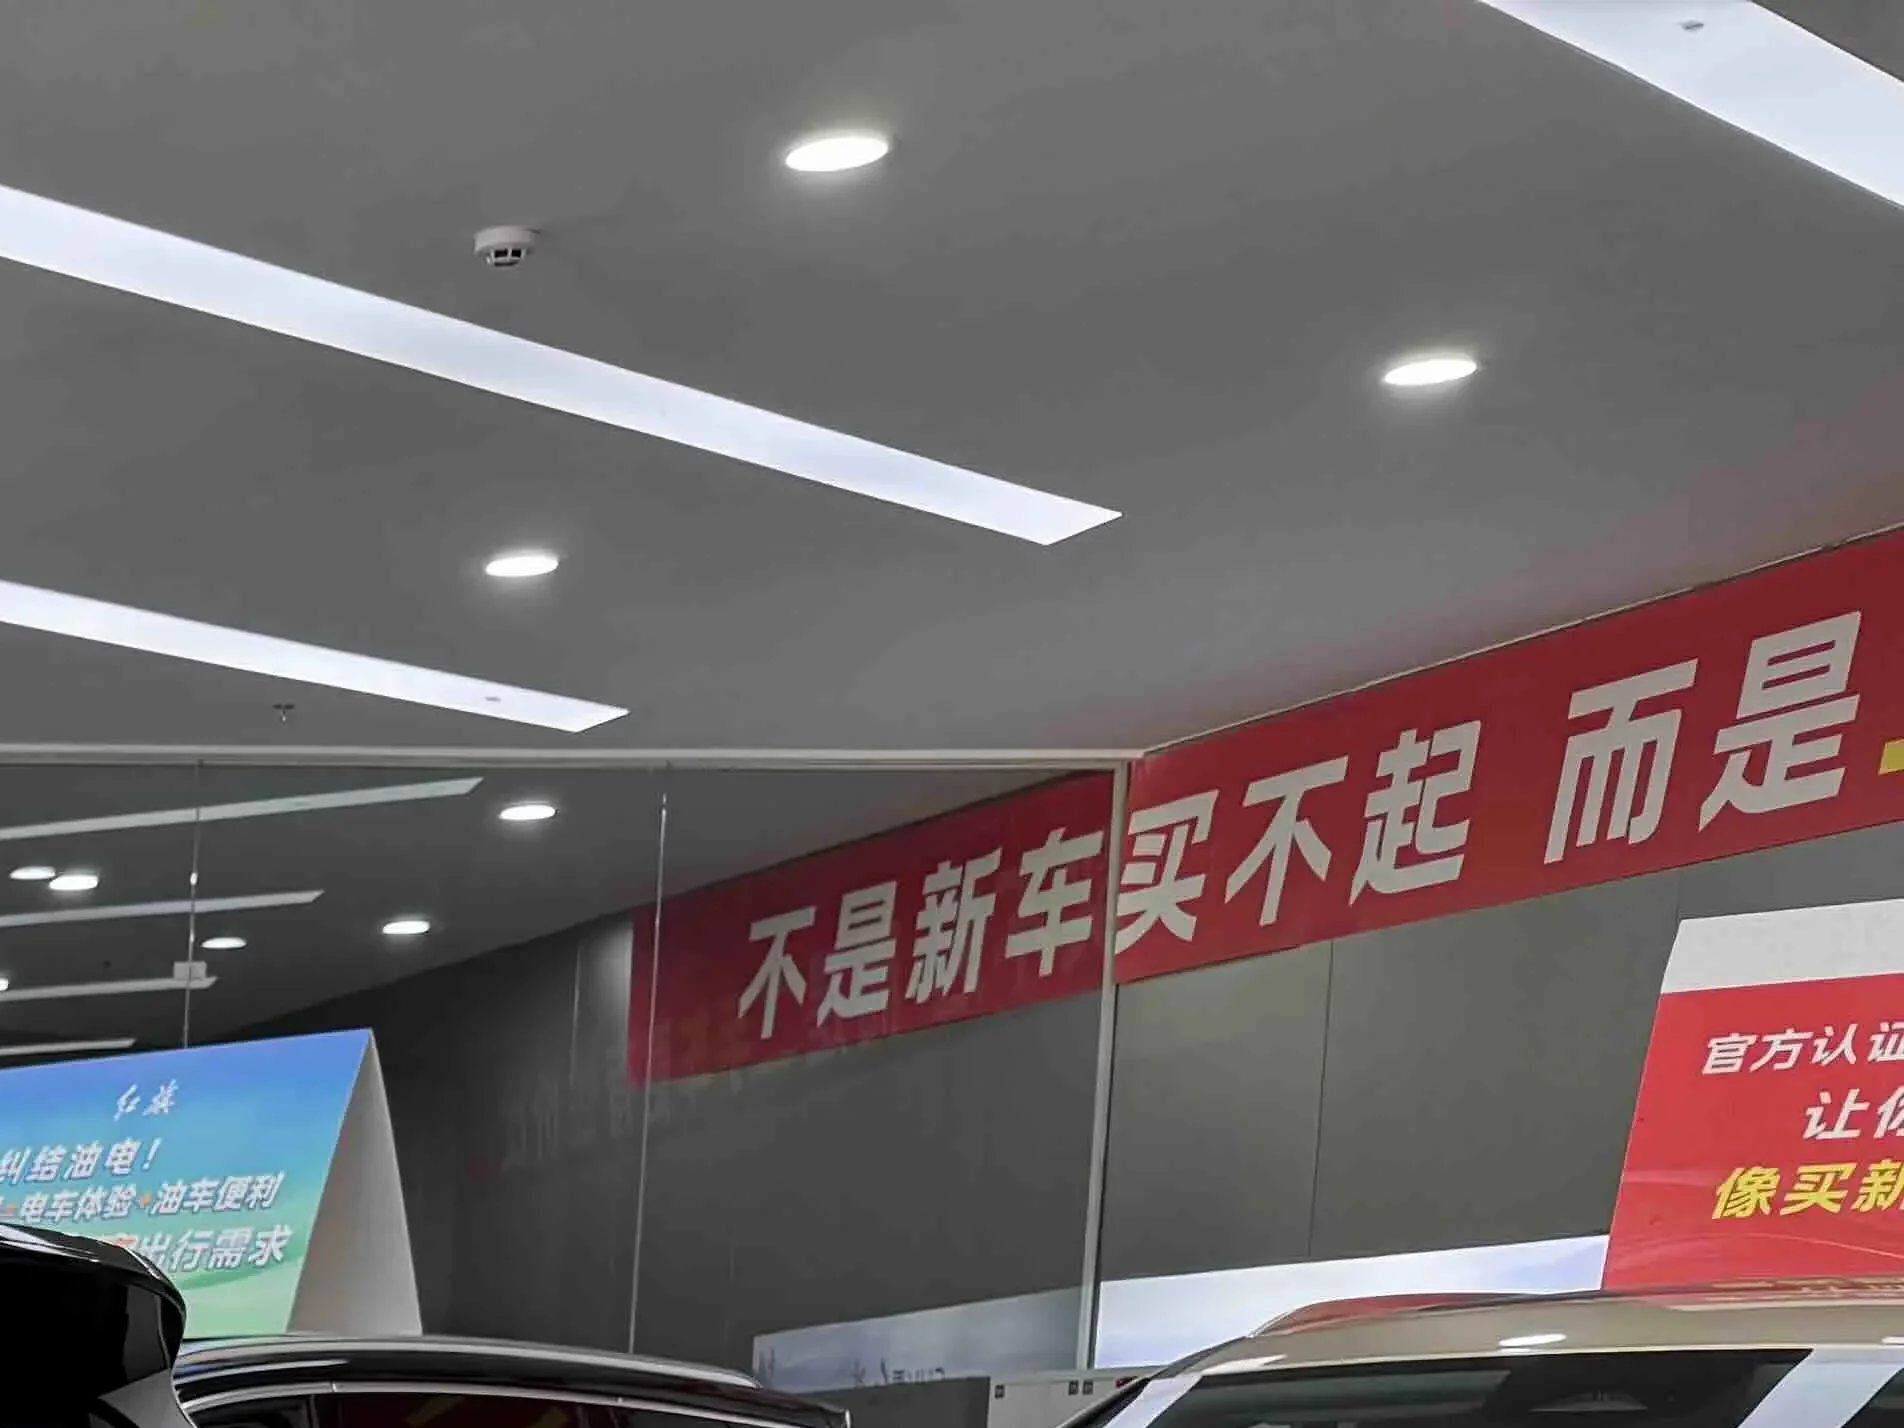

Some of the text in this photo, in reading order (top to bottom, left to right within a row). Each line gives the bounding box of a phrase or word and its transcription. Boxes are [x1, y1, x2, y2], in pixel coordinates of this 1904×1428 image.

[738, 610, 1862, 1040] 不是新车买不起 而是
[1701, 1021, 1904, 1076] 官方认证
[1711, 1158, 1904, 1220] 像买新
